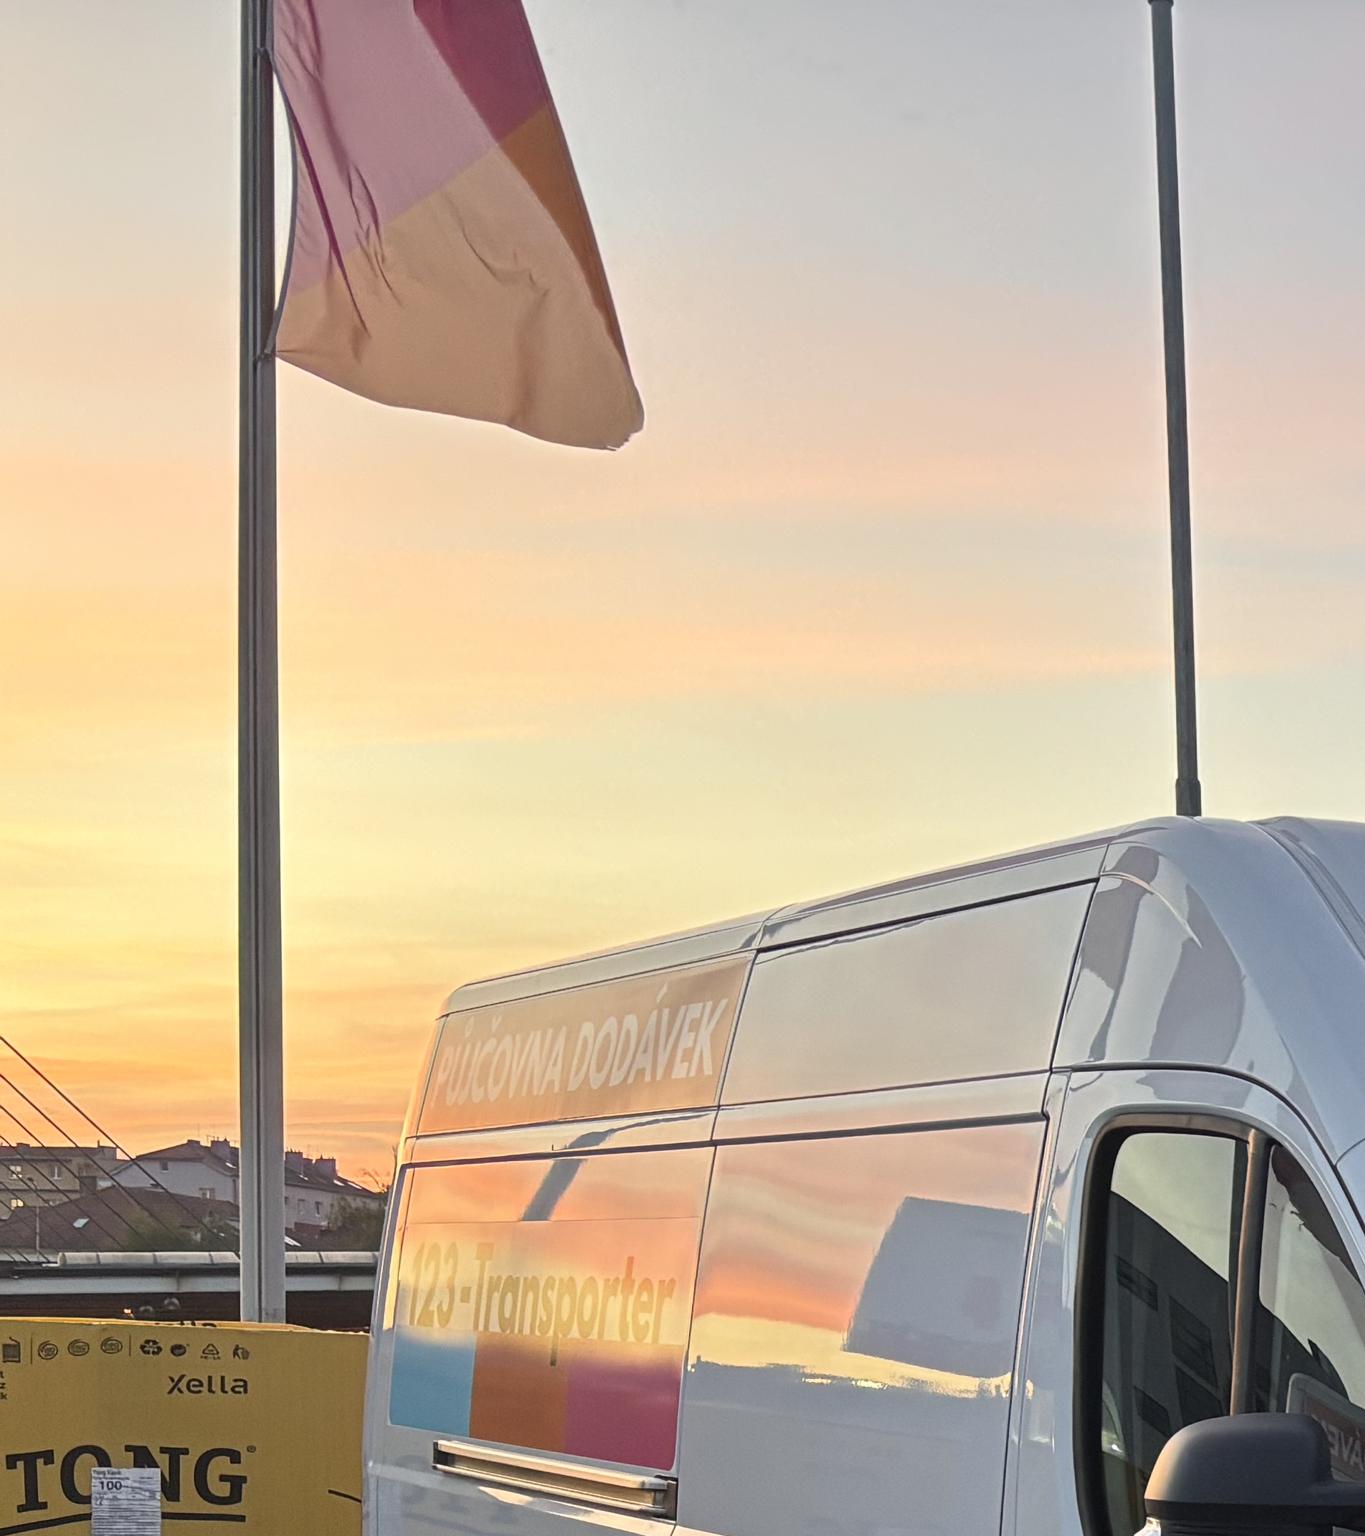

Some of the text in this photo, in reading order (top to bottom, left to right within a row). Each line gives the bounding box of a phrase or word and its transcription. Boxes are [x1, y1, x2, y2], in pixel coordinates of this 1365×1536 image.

[433, 985, 727, 1106] PŮJČOVNA DODÁVEK
[5, 1444, 248, 1513] TONG
